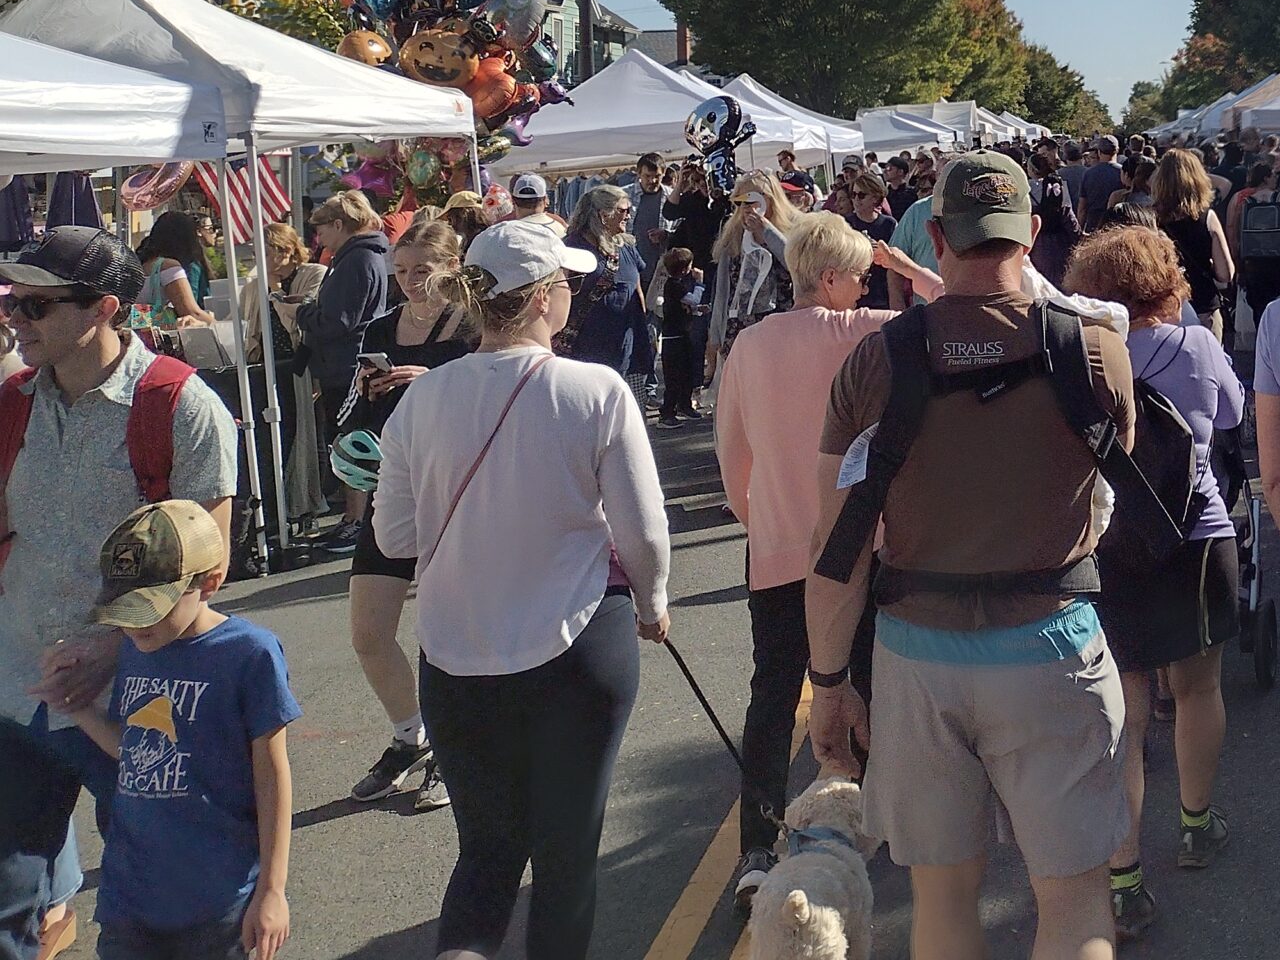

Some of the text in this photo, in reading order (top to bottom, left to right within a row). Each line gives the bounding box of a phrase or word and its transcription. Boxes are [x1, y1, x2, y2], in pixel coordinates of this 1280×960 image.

[943, 341, 1004, 356] STRAUSS
[120, 676, 210, 722] THE SALTY
